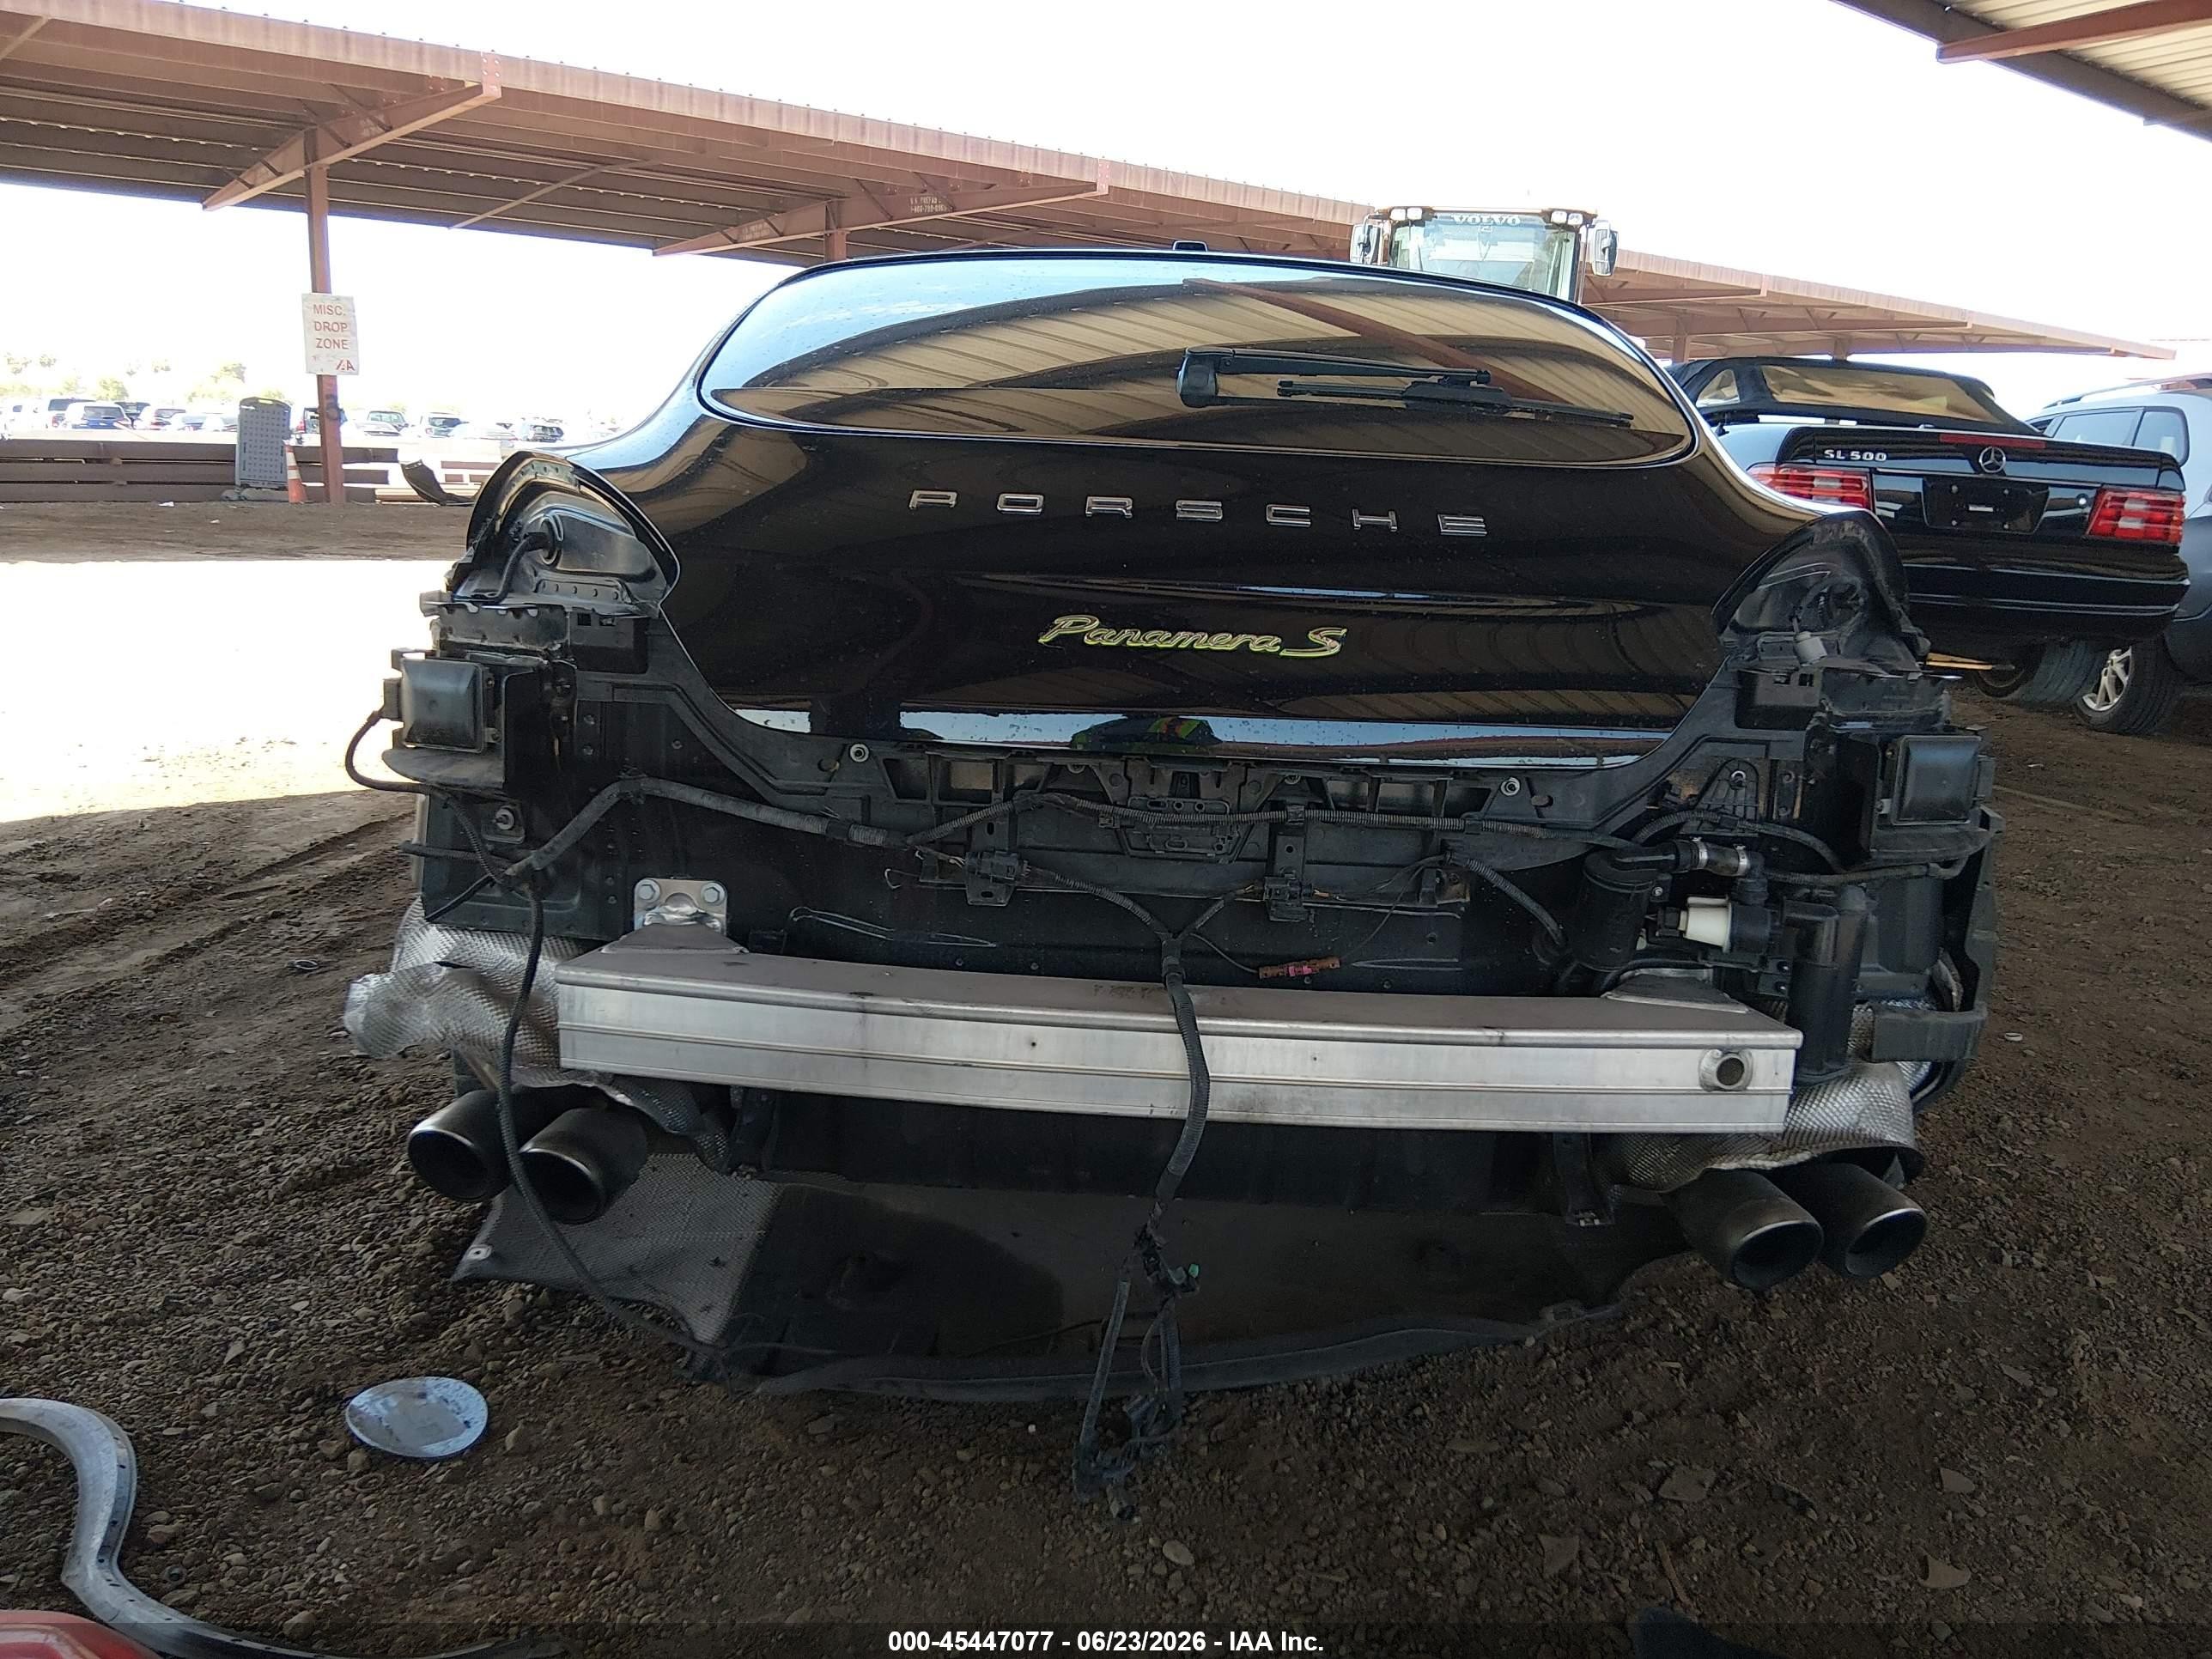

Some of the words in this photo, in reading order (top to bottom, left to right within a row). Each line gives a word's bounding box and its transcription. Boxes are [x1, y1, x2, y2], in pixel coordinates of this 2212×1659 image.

[1453, 213, 1521, 227] VOLVO
[313, 304, 347, 316] MISC.
[313, 321, 348, 333] DROP
[315, 337, 349, 350] ZONE
[1823, 449, 1846, 459] SL
[1850, 451, 1887, 462] 500
[908, 489, 1488, 537] PORSCHE
[1038, 614, 1281, 654] Panamera
[1279, 626, 1348, 658] S
